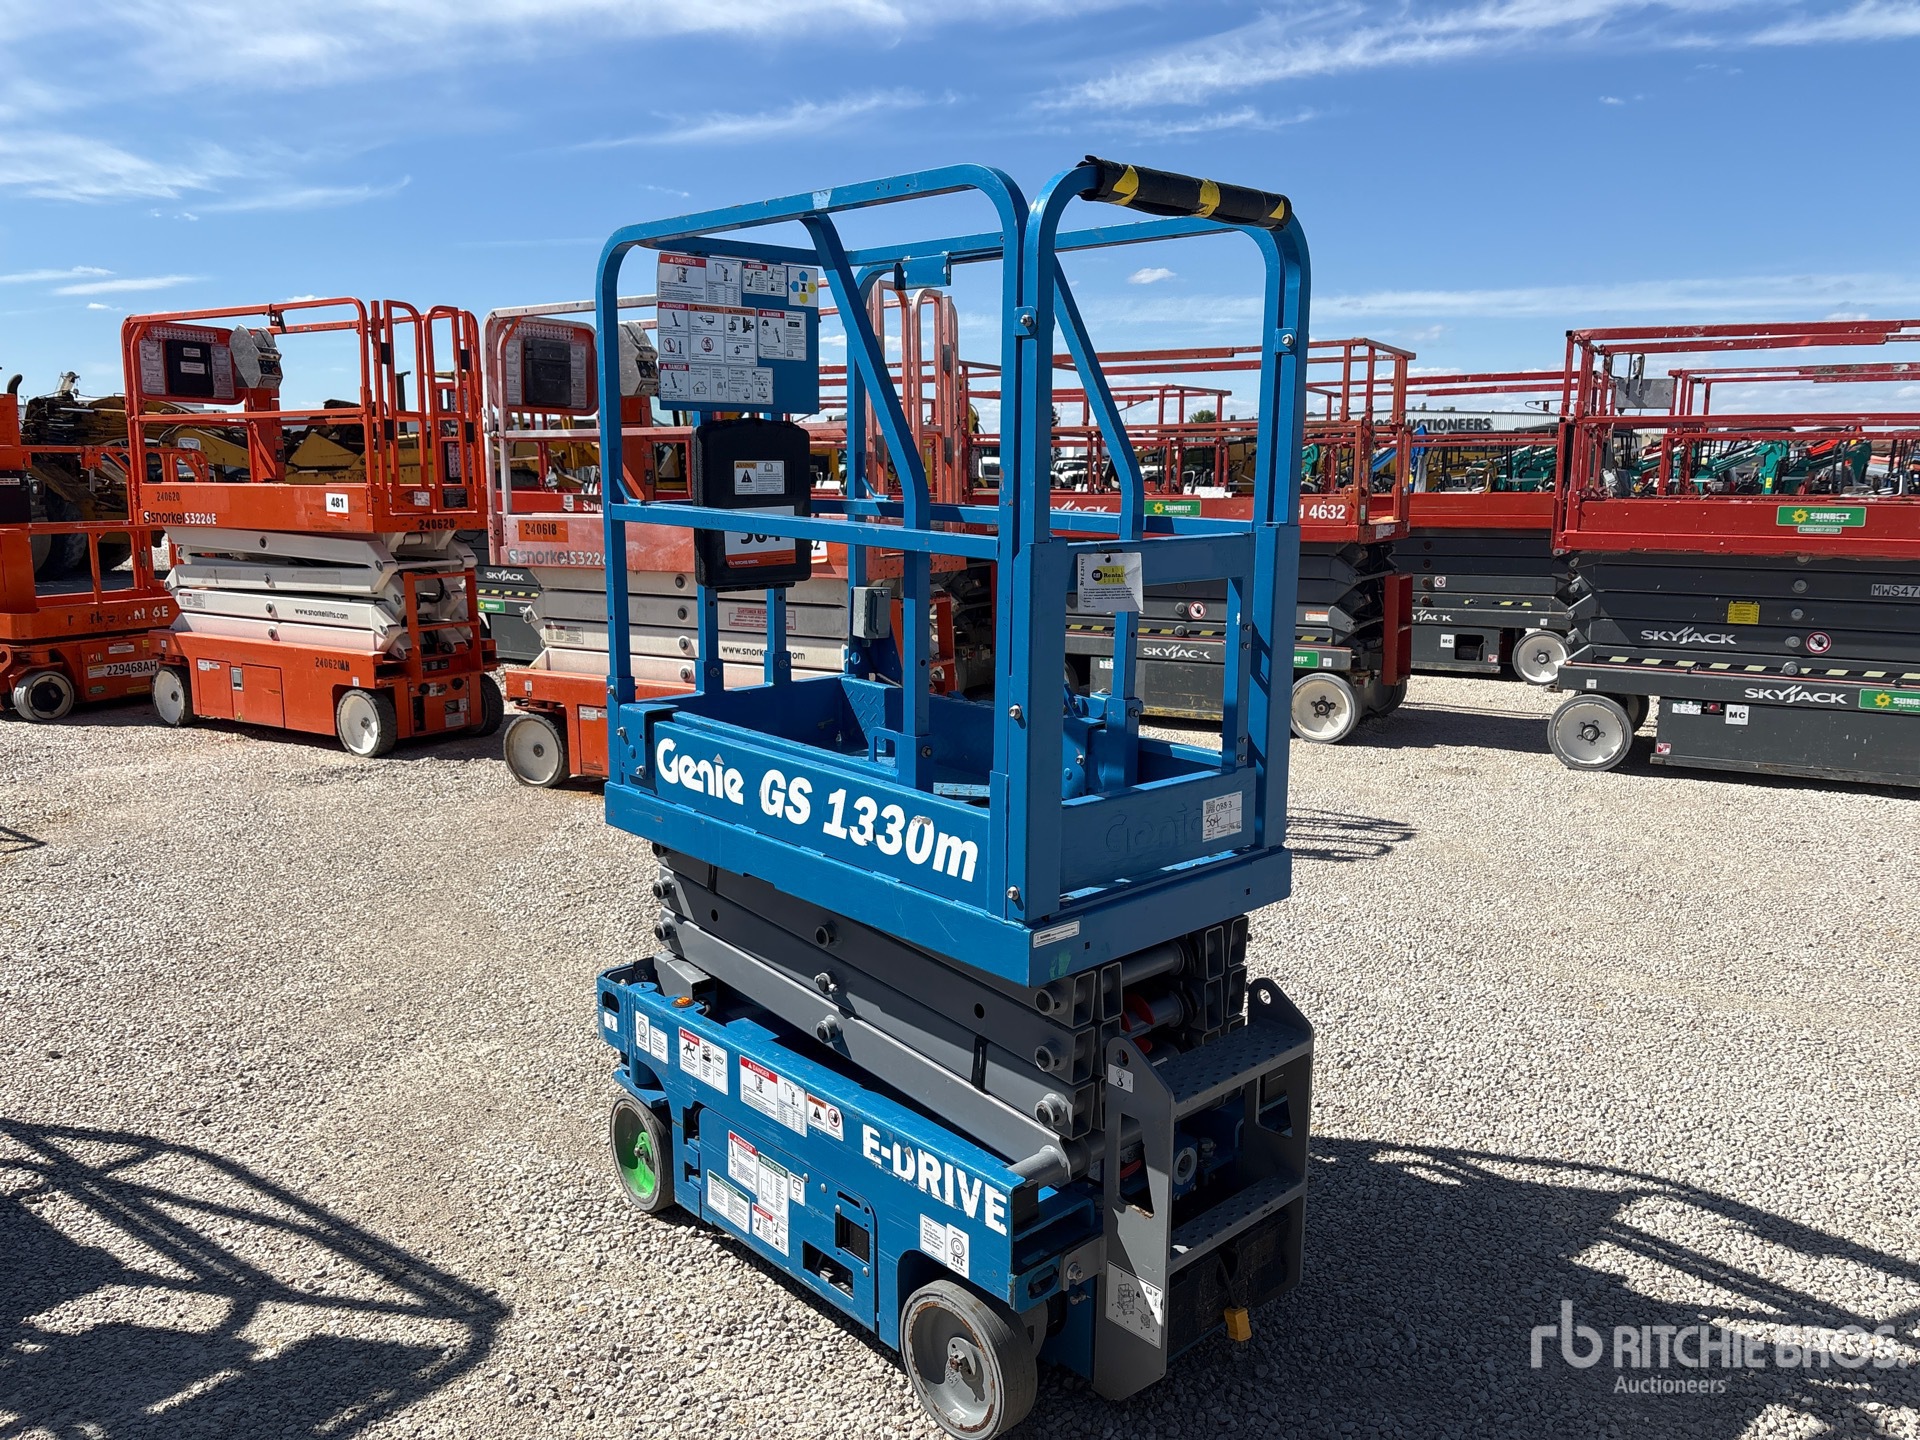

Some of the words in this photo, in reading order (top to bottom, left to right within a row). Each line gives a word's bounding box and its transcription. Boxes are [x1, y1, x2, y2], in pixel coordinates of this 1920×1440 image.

[675, 257, 697, 266] DANGER
[1407, 418, 1492, 431] UCTIONEERS
[156, 491, 180, 502] 240620
[330, 497, 344, 508] 481
[1308, 504, 1346, 519] 4632
[184, 512, 217, 525] S3226E
[418, 518, 455, 530] 240620
[525, 523, 557, 535] 240618
[486, 569, 525, 582] SKYJACK
[1872, 584, 1920, 597] MWS47
[1640, 626, 1738, 645] SKYJACK
[106, 660, 157, 676] 229468AH
[1744, 684, 1848, 704] SKYJACK
[1728, 711, 1746, 719] MC
[656, 737, 745, 806] Genie
[759, 769, 814, 825] GS
[822, 787, 979, 883] 1330m
[752, 1064, 770, 1079] DANGER
[862, 1123, 1008, 1237] E-DRIVE
